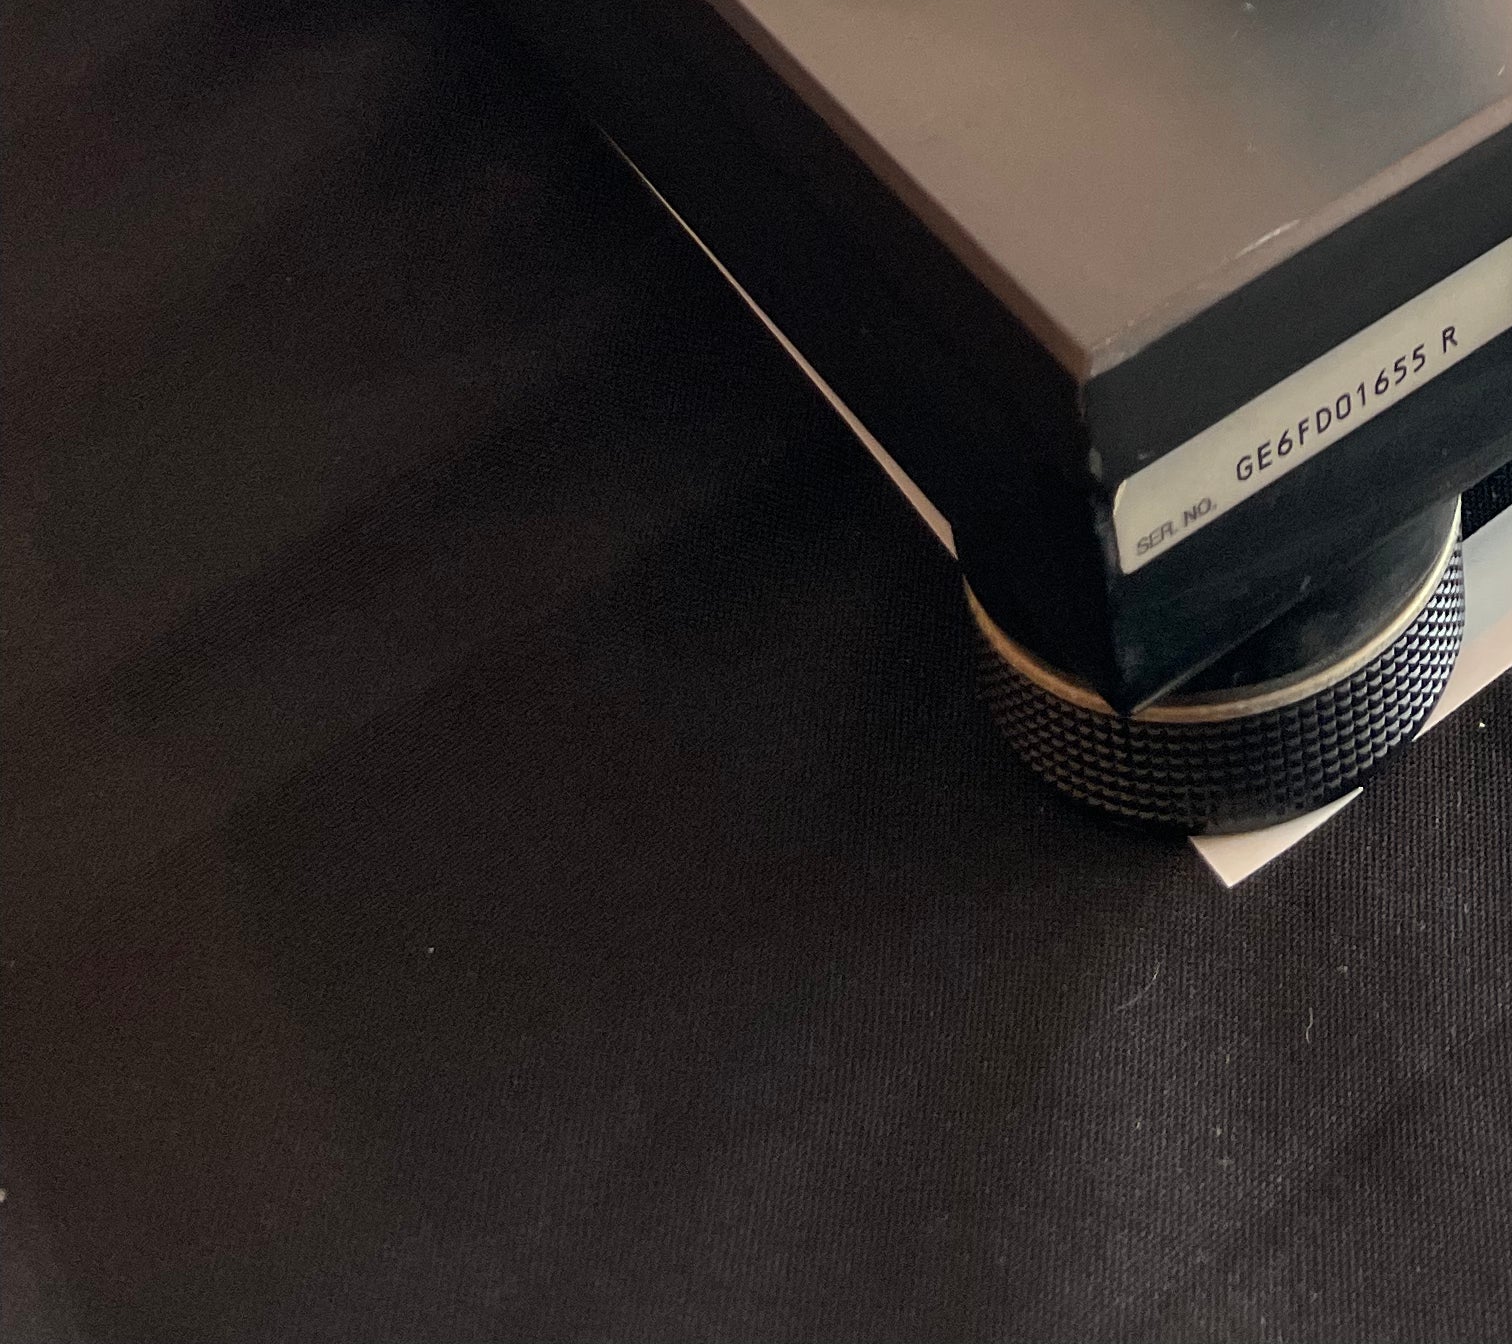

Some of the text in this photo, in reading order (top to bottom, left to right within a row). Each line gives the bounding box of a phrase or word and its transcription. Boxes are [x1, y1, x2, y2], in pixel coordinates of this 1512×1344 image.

[1235, 325, 1458, 483] GE6FD01655 R
[1136, 497, 1218, 557] SER. NO.
